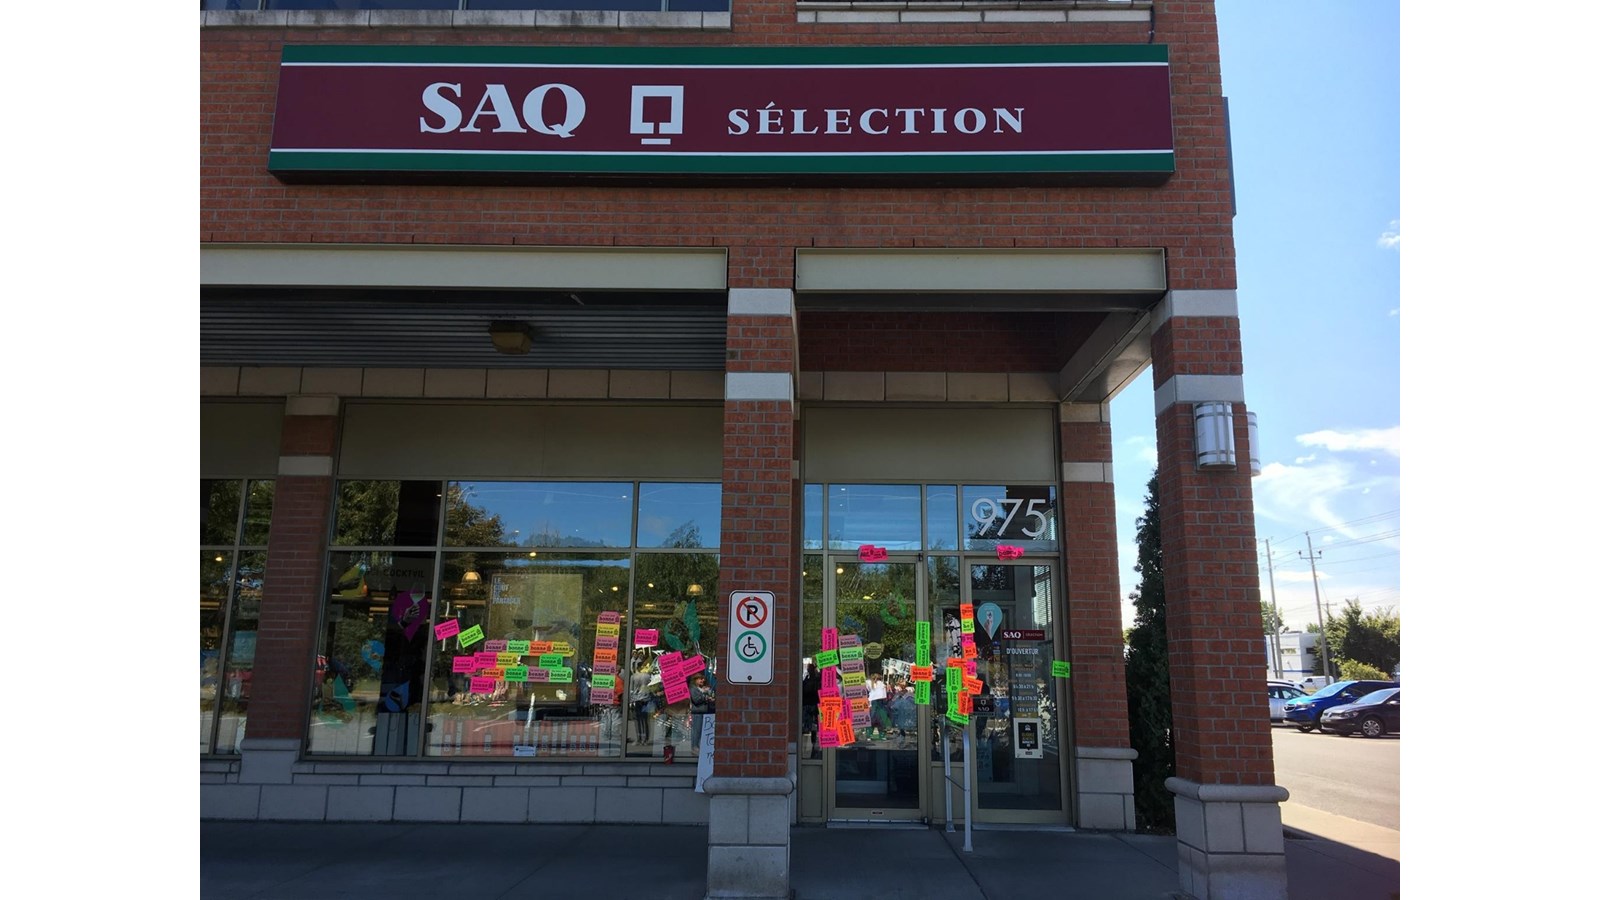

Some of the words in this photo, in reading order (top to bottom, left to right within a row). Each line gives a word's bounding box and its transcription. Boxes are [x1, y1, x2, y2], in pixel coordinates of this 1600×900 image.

[420, 82, 585, 138] SAQ
[728, 101, 1024, 135] SÉLECTION
[971, 498, 1047, 537] 975
